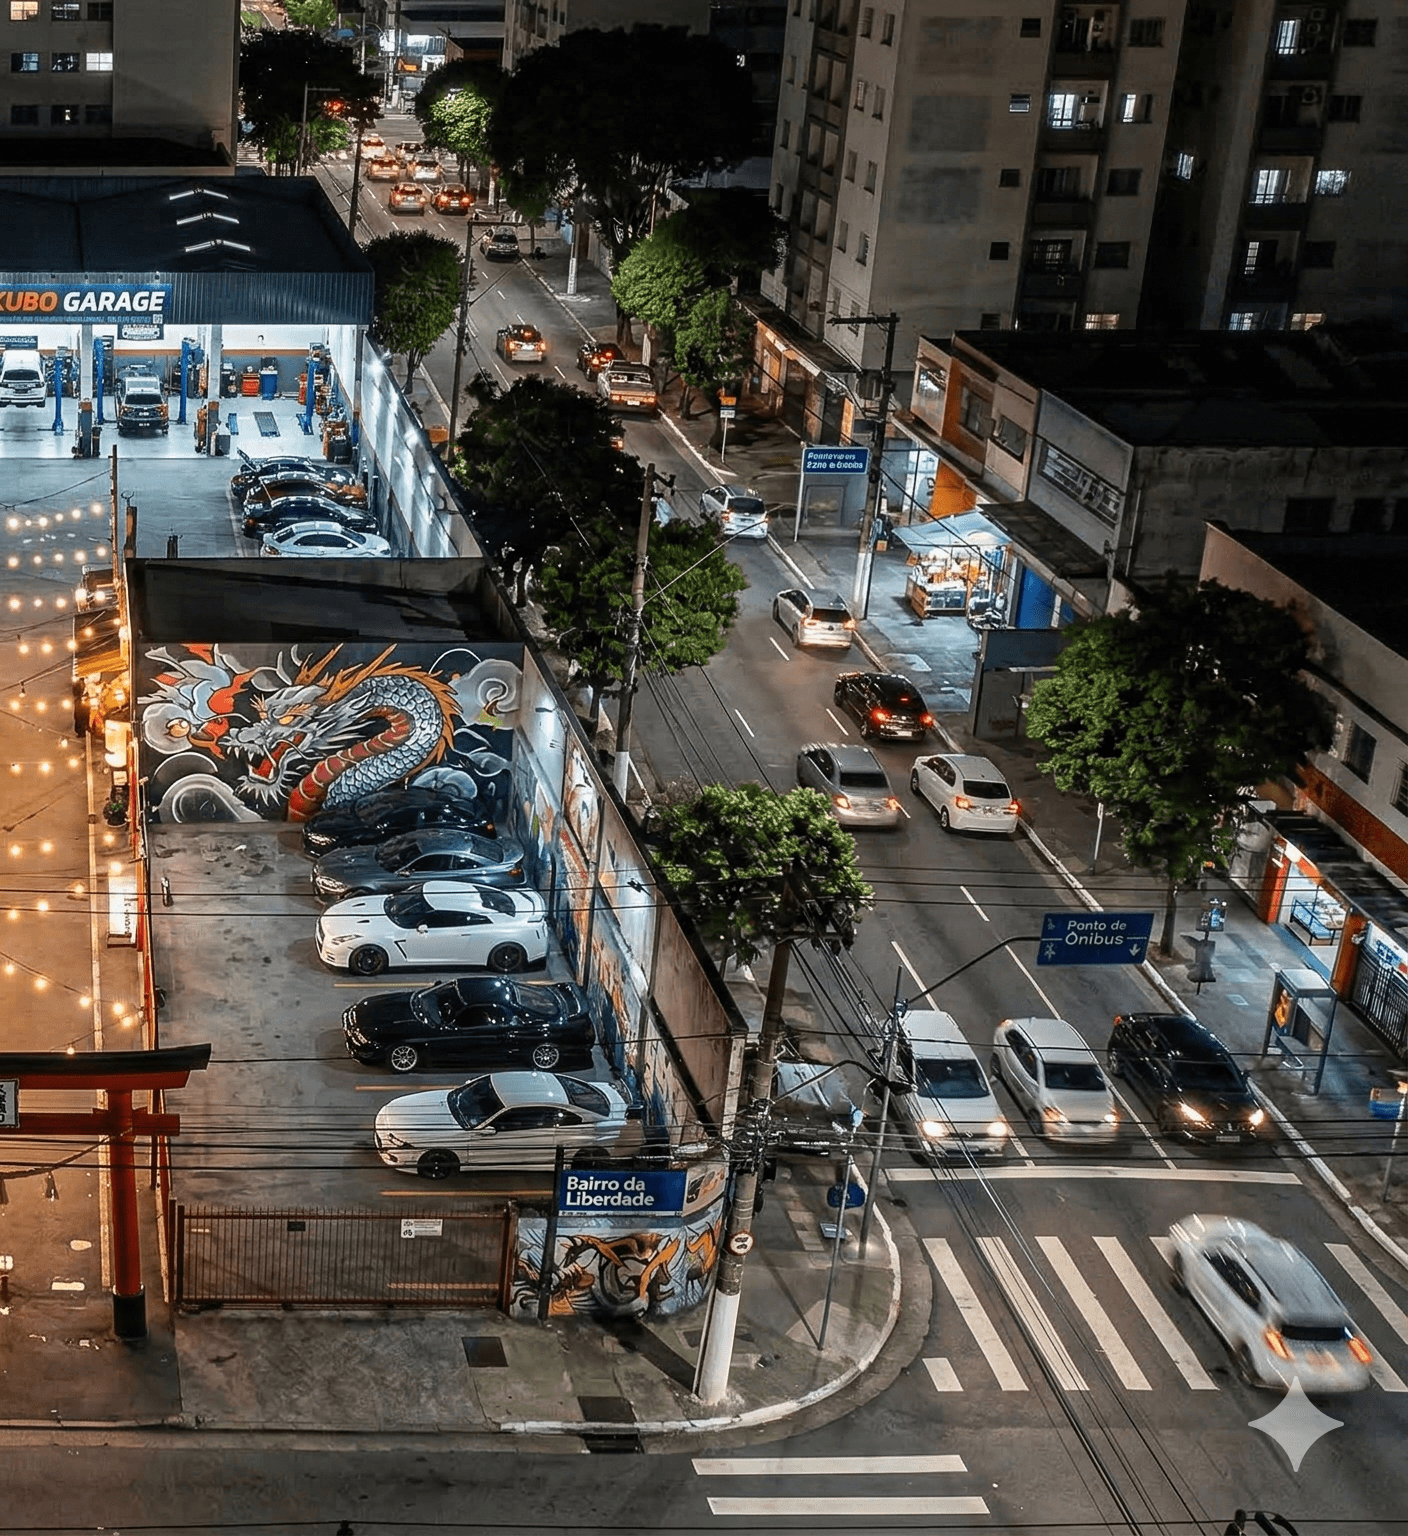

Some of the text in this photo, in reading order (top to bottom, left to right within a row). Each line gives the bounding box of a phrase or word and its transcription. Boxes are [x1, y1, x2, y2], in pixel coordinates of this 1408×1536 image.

[63, 291, 166, 312] GARAGE
[1067, 920, 1127, 931] Ponto de
[1065, 931, 1124, 945] Ônibus
[567, 1176, 646, 1191] Bairro da
[565, 1192, 654, 1206] Liberdade
